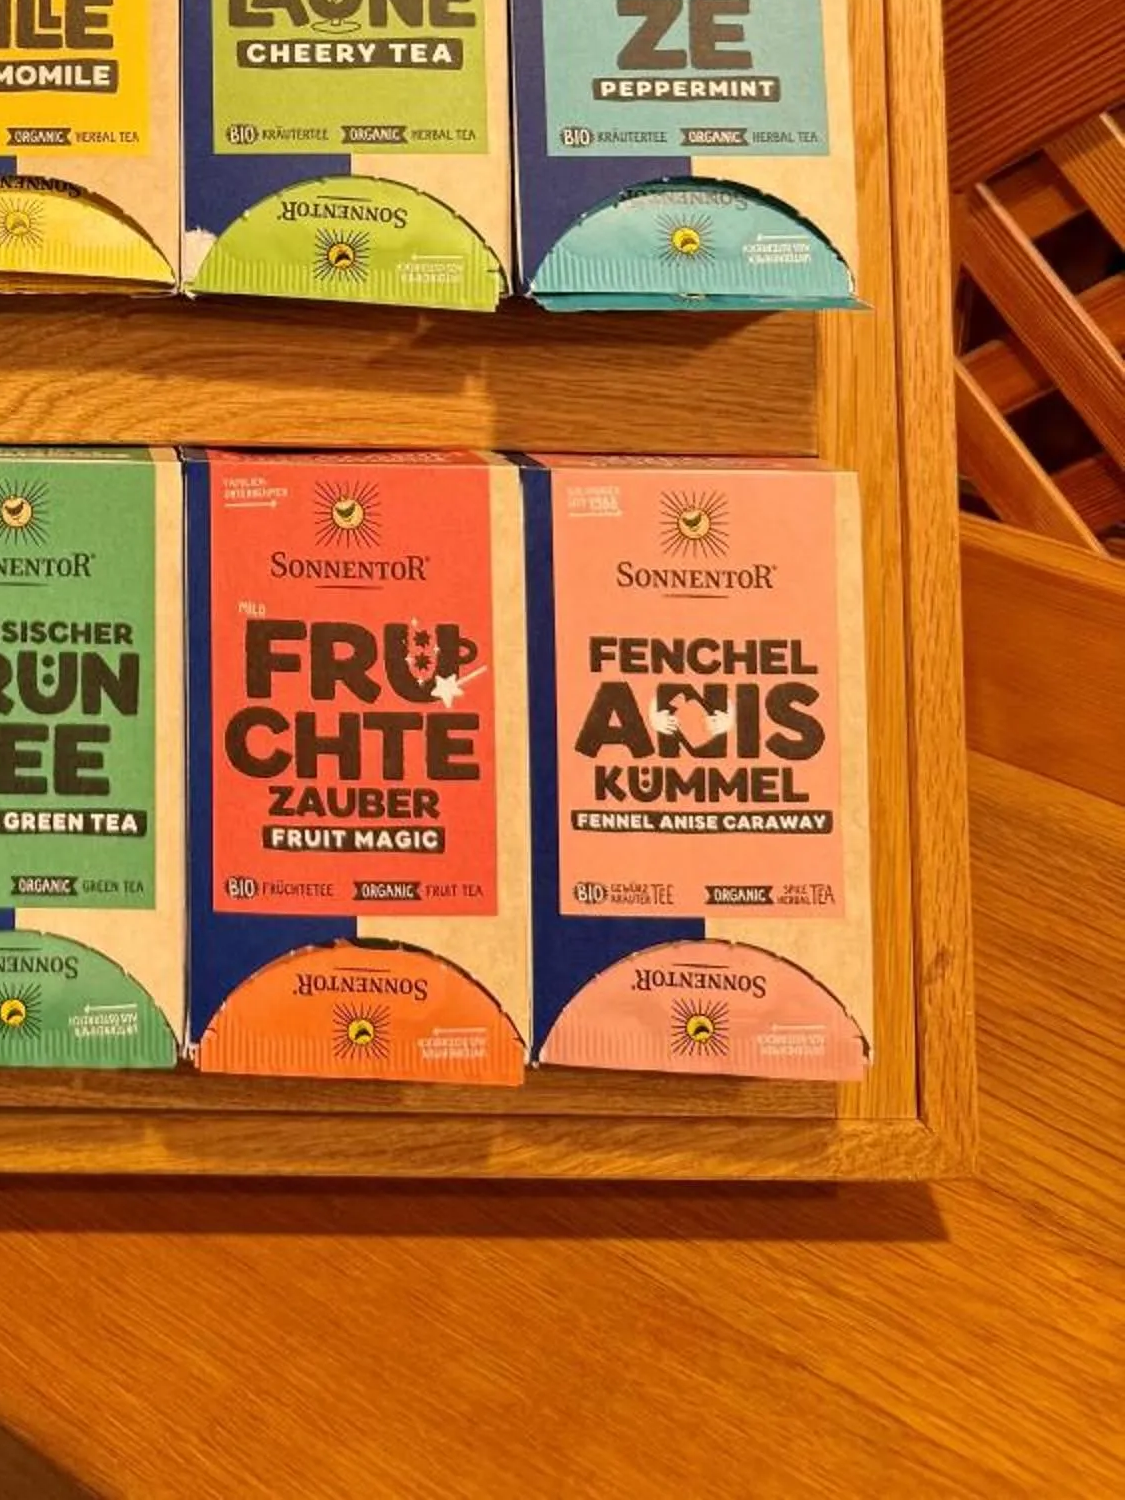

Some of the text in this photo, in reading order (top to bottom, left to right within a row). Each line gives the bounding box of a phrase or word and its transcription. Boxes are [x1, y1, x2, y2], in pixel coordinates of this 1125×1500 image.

[246, 43, 453, 64] CHEERY TEA
[600, 79, 775, 98] PEPPERMINT
[13, 129, 65, 144] ORGANIC
[76, 130, 115, 143] HERBAL
[120, 130, 139, 143] TEA
[229, 126, 255, 144] BIO
[348, 127, 401, 142] ORGANIC
[412, 129, 451, 141] HERBAL
[456, 129, 475, 141] TEA
[562, 127, 591, 146] BIO
[687, 130, 742, 143] ORGANIC
[753, 131, 794, 143] HERBAL
[798, 131, 818, 143] TEA
[281, 201, 408, 228] SONNENTOR
[271, 551, 426, 581] SONNENTOR
[617, 561, 773, 589] SONNENTOR
[238, 599, 266, 616] MILD
[589, 636, 818, 675] FENCHEL
[575, 681, 825, 761] ANIS
[225, 706, 480, 780] CHTE
[594, 766, 809, 803] KÜMMEL
[268, 786, 441, 819] ZAUBER
[4, 812, 84, 831] GREEN
[91, 813, 138, 833] TEA
[577, 813, 826, 830] FENNEL ANISE CARAWAY
[272, 828, 438, 850] FRUIT MAGIC
[18, 878, 72, 893] ORGANIC
[82, 880, 118, 893] GREEN
[124, 880, 144, 893] TEA
[228, 877, 255, 898] BIO
[361, 883, 414, 898] ORGANIC
[425, 884, 456, 897] FRUIT
[462, 884, 484, 897] TEA
[576, 884, 604, 903] BIO
[651, 883, 674, 905] TEE
[713, 887, 766, 902] ORGANIC
[811, 883, 835, 905] TEA
[298, 973, 428, 1000] SONNENTOR
[635, 968, 765, 998] SONNENTOR
